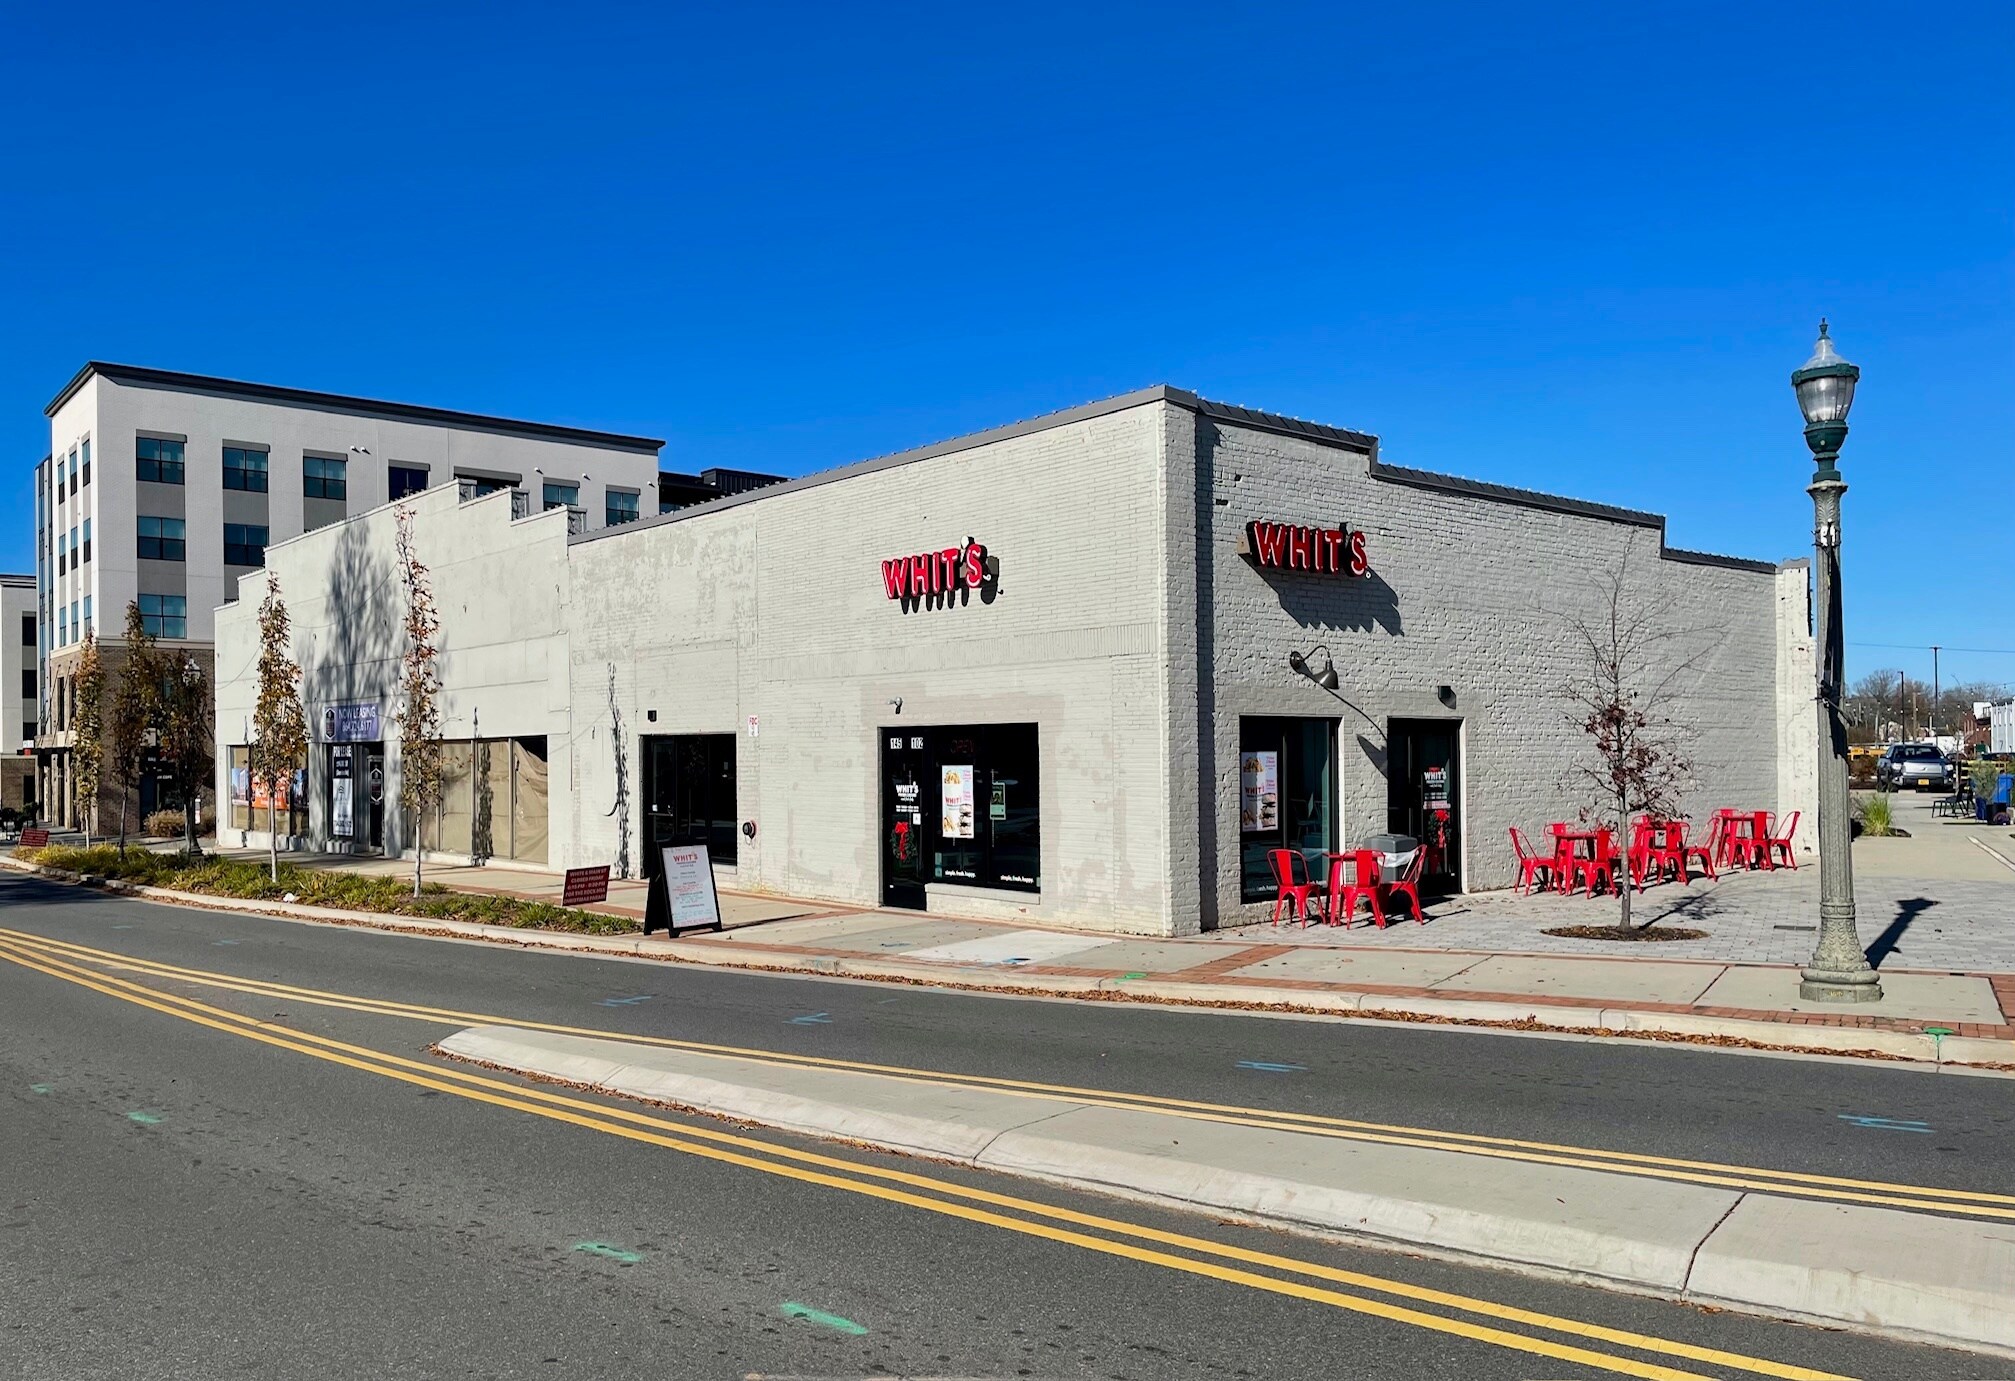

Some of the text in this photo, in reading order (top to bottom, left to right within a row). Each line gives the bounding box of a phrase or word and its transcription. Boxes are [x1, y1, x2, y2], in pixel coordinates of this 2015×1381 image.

[1246, 519, 1368, 577] WHIT'S
[881, 535, 984, 600] WHIT'S
[1424, 768, 1447, 780] WHIT'S
[896, 781, 919, 793] WHIT'S
[673, 852, 698, 862] WHIT'S
